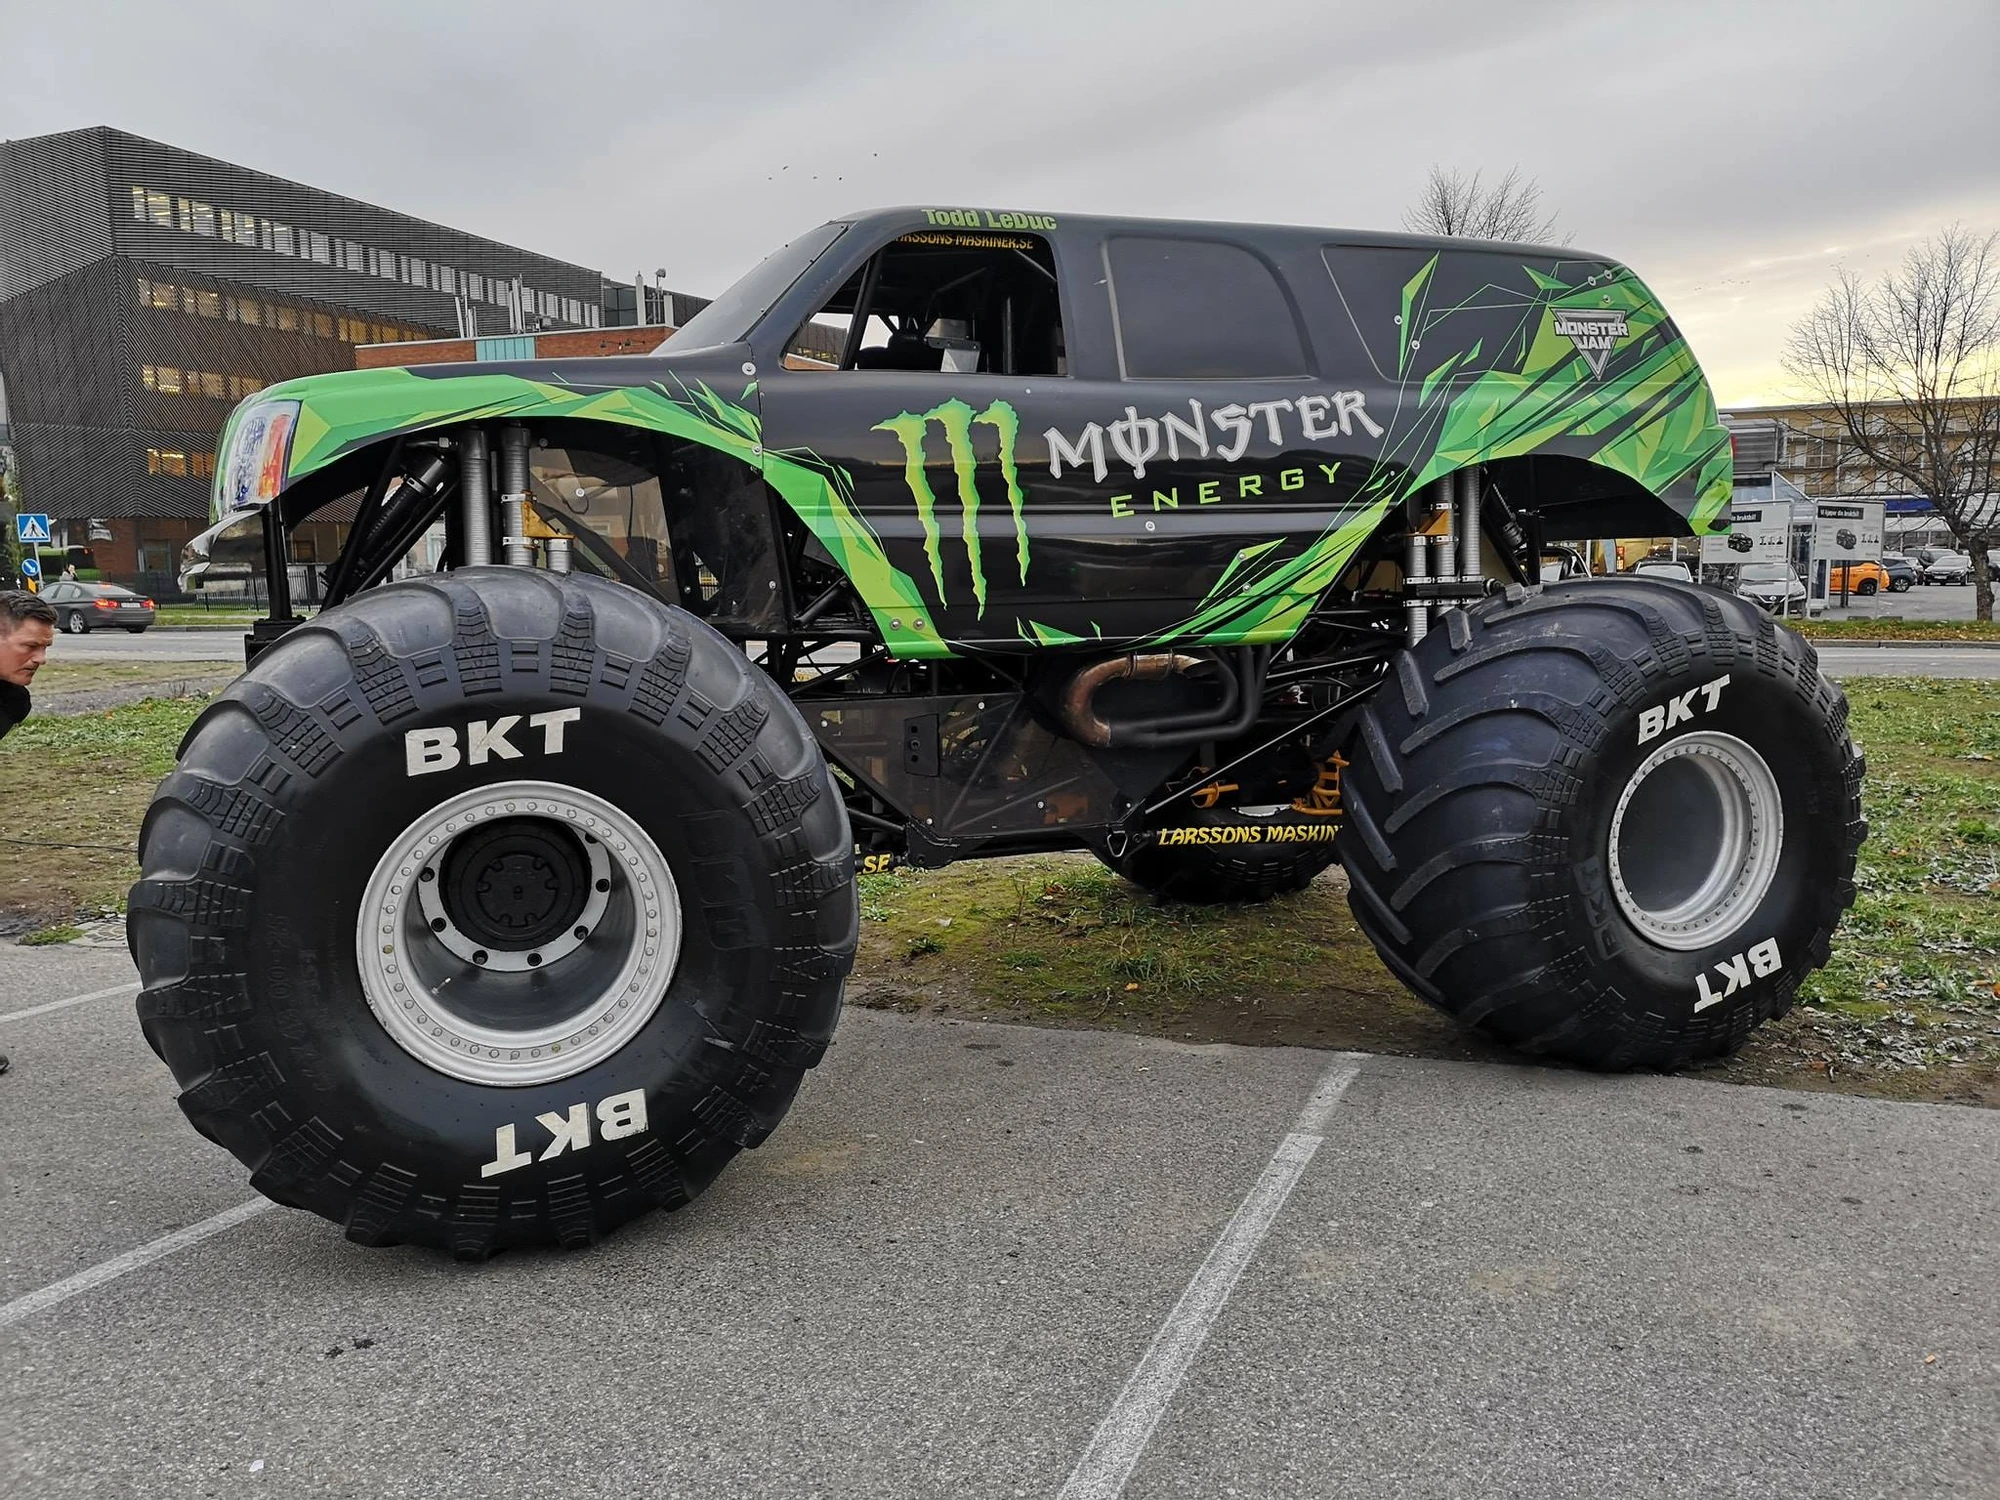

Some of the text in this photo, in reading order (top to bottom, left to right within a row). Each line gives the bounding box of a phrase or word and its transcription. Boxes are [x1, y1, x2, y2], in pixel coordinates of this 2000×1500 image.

[922, 208, 1057, 230] Todd LeDuc
[1555, 321, 1629, 336] MONSTER
[1577, 335, 1613, 350] JAM
[1043, 390, 1384, 482] MONSTER
[1111, 462, 1342, 518] ENERGY
[1637, 674, 1731, 745] BKT
[405, 707, 581, 777] BKT
[1158, 825, 1343, 845] LARSSONS MASKIN
[1694, 937, 1783, 1014] BKT
[481, 1088, 649, 1178] BKT
